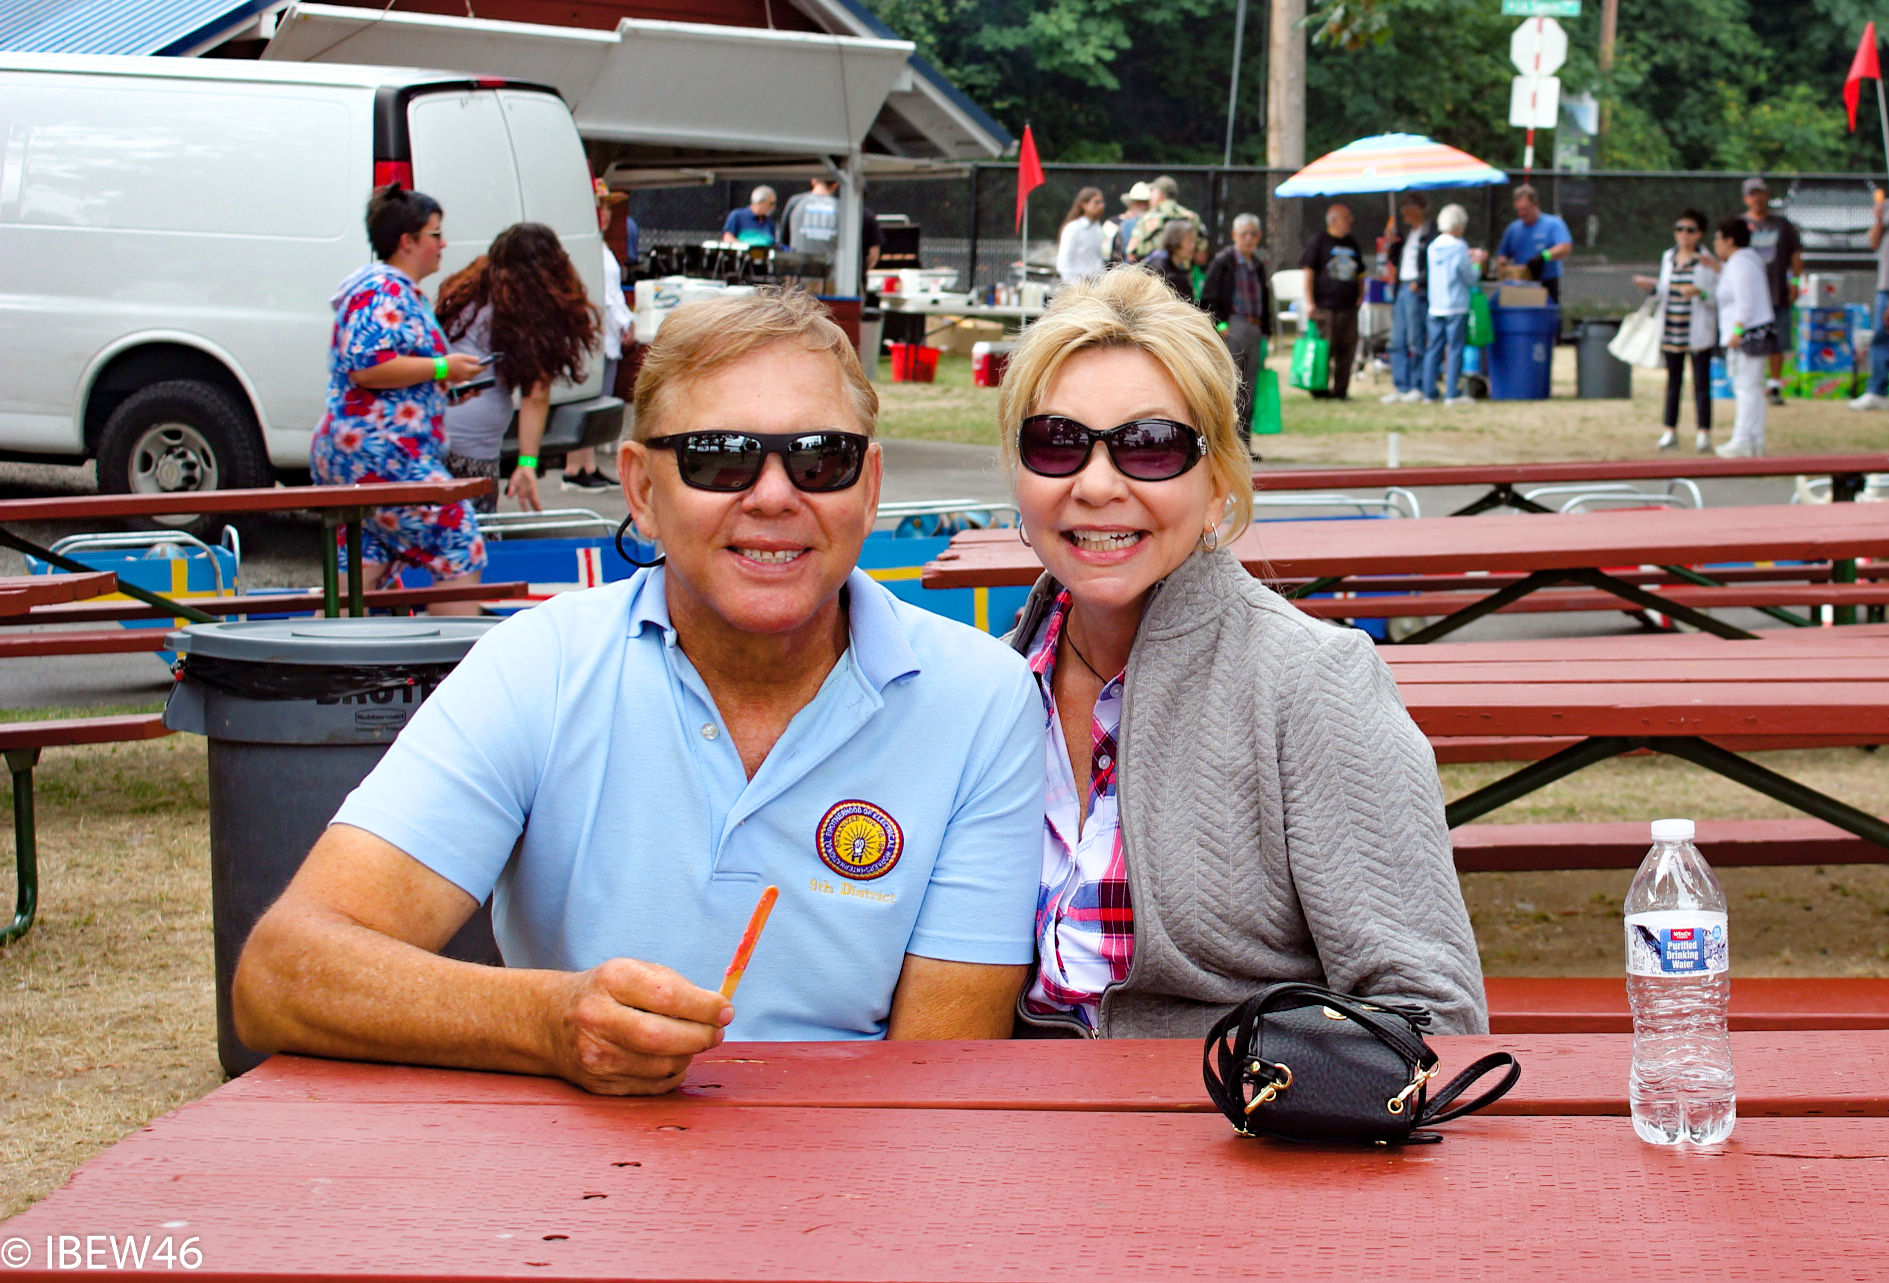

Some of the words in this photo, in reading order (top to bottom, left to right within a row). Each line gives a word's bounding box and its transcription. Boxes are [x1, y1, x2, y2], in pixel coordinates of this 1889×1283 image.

[826, 806, 862, 837] BROTHERHOOD
[863, 809, 874, 817] OF
[872, 812, 895, 849] ELECTRICAL
[809, 878, 834, 893] 9th
[840, 882, 897, 903] District
[1667, 940, 1697, 950] Purified
[1666, 950, 1699, 960] Drinking
[1672, 960, 1694, 969] Water
